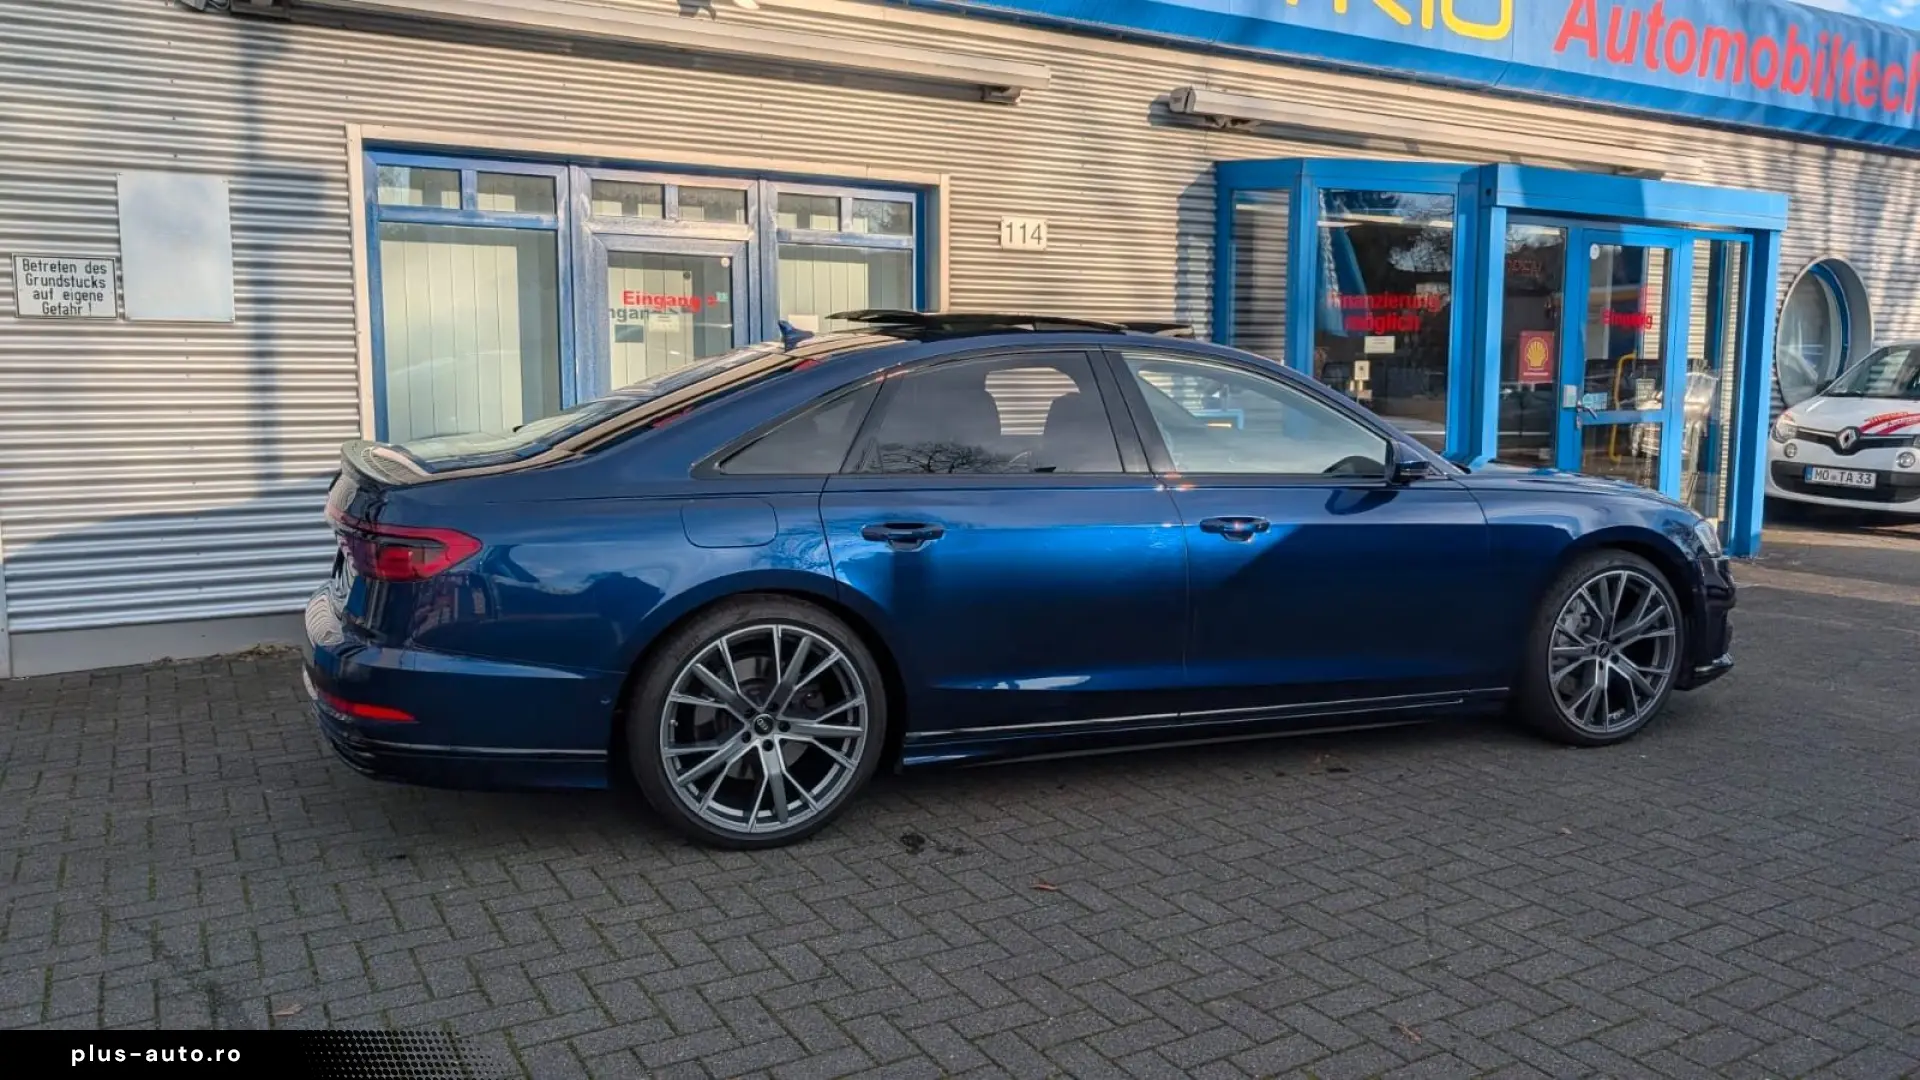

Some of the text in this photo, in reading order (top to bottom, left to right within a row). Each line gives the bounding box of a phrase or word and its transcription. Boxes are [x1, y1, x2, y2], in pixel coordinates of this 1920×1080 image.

[1005, 221, 1043, 245] 114
[22, 258, 107, 274] Betreten des
[33, 288, 104, 305] auf eigene
[42, 301, 83, 315] Gefahr
[1839, 472, 1853, 483] TA
